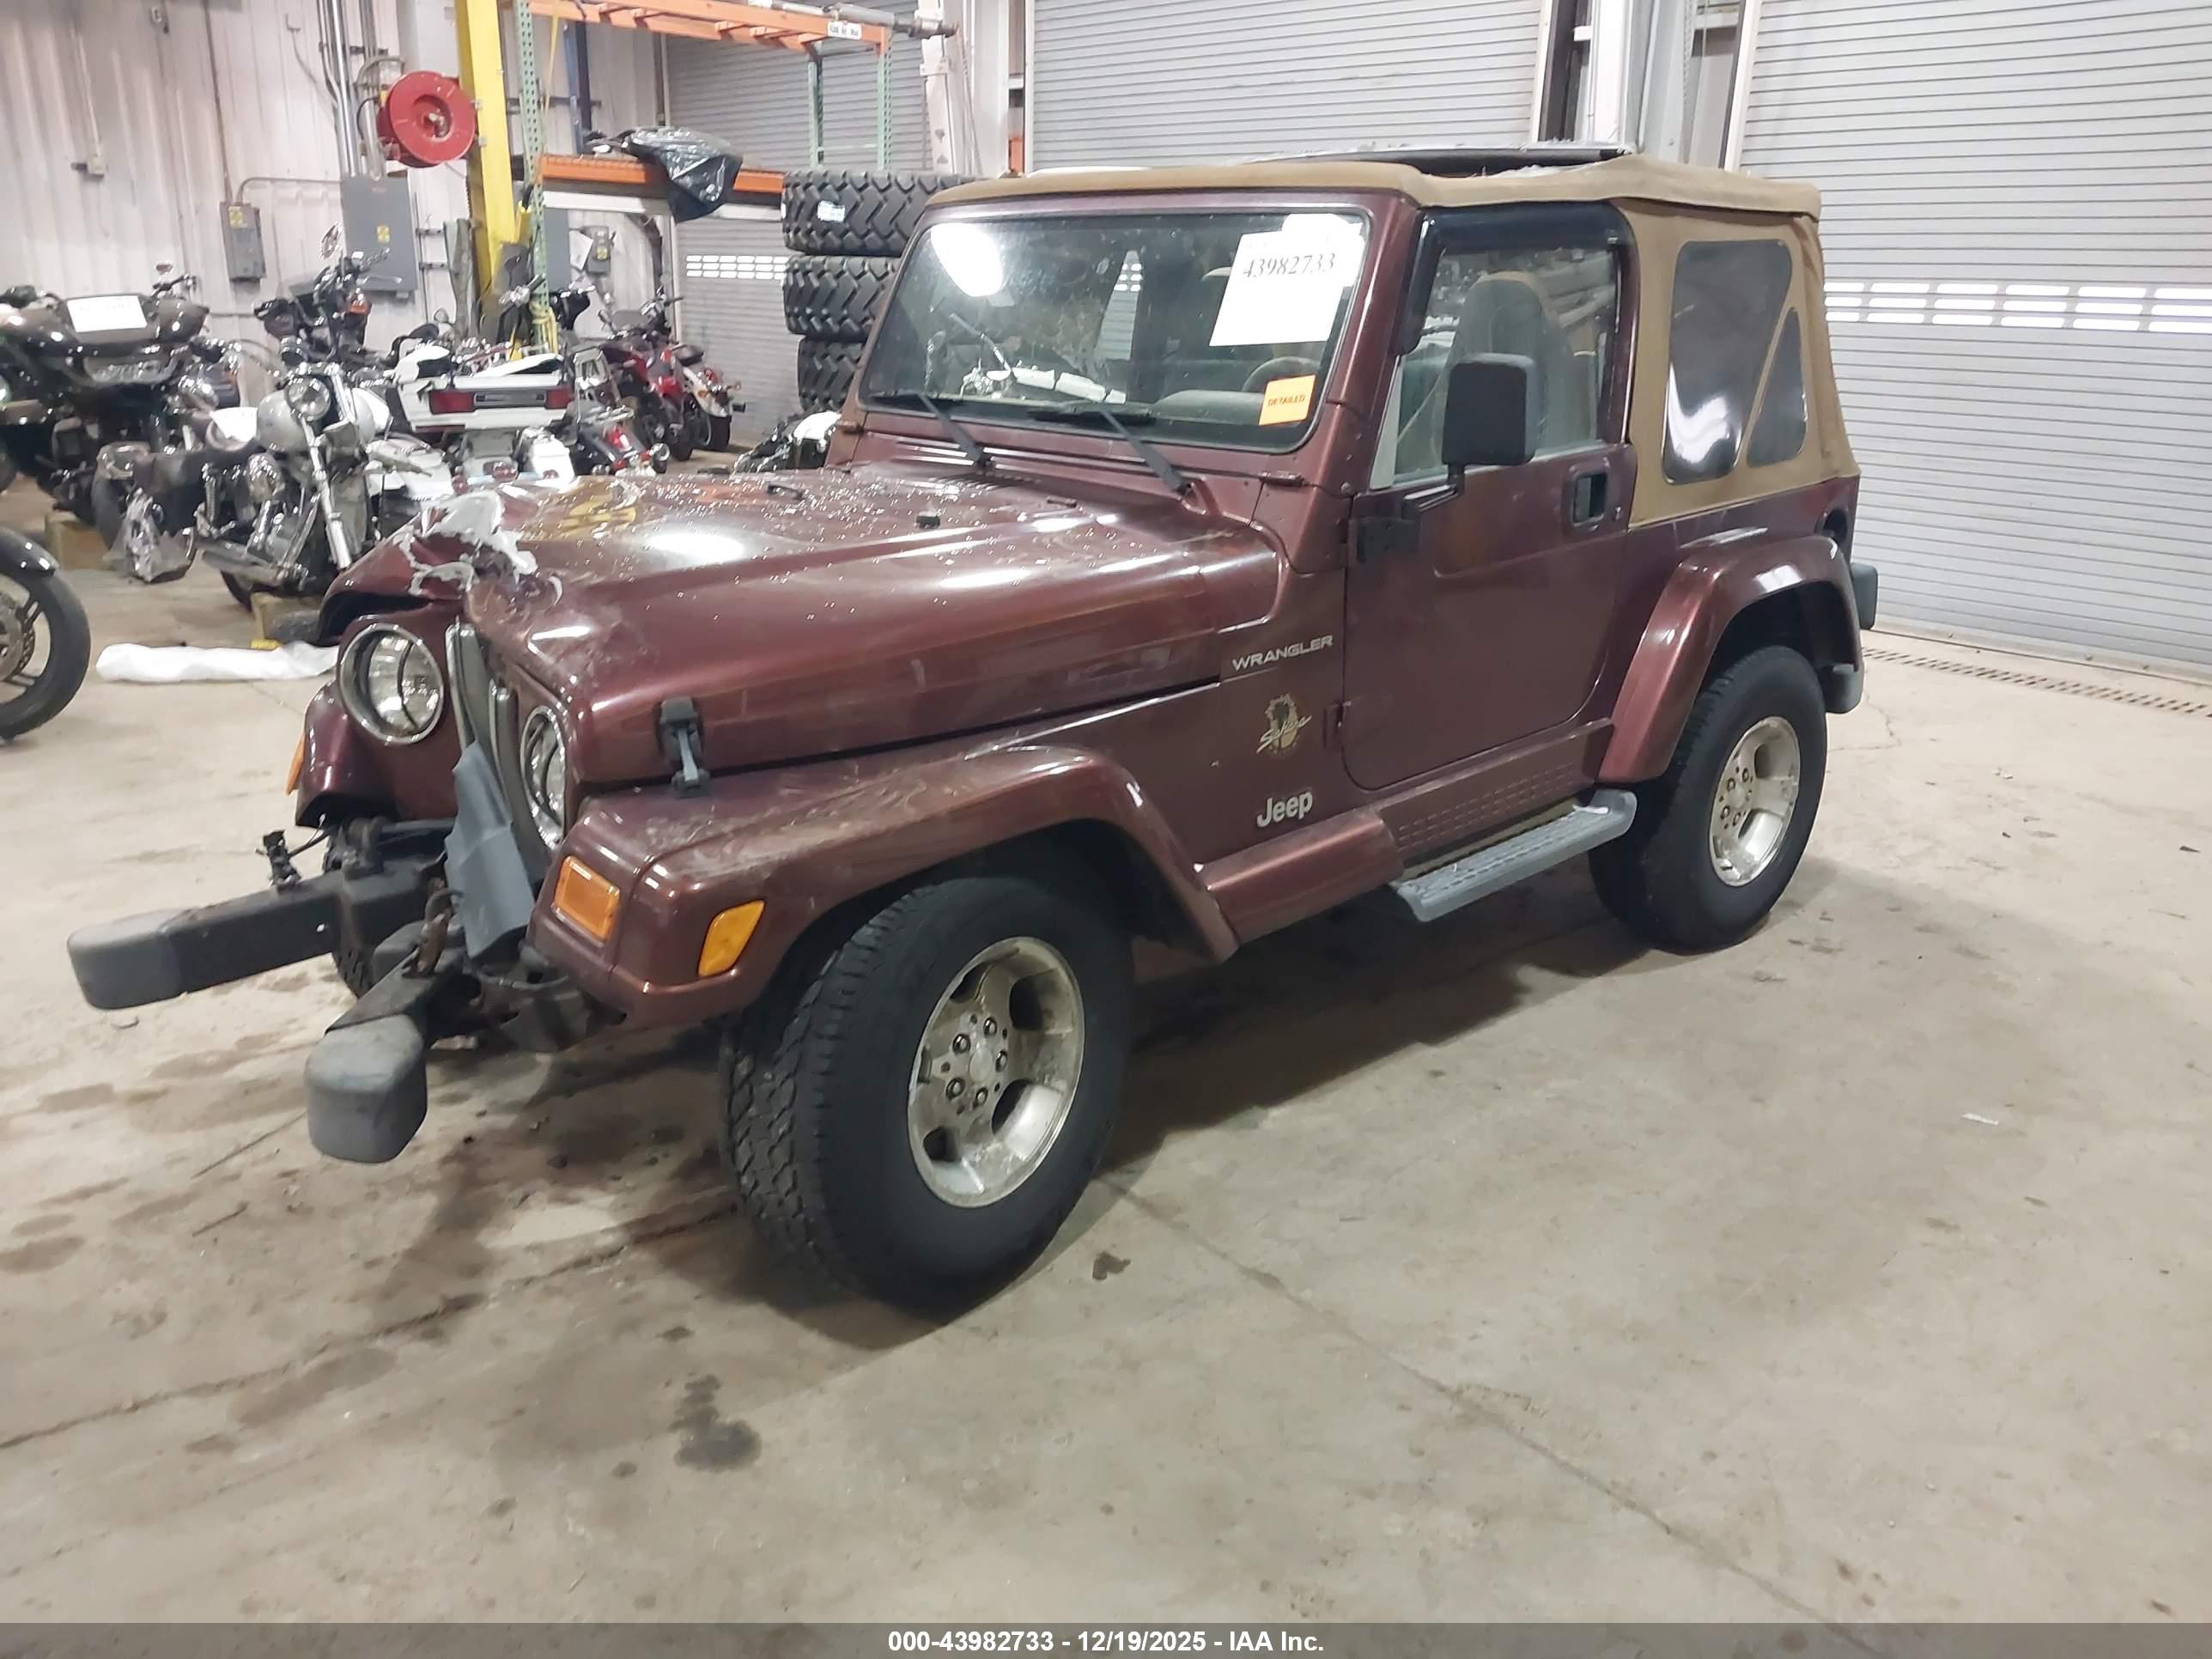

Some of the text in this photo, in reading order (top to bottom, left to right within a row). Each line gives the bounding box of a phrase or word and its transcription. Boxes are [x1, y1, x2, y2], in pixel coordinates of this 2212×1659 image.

[1243, 252, 1335, 278] 43982733
[1267, 393, 1306, 407] DETAILED
[1232, 635, 1334, 671] WRANGLER
[1256, 790, 1314, 829] Jeep
